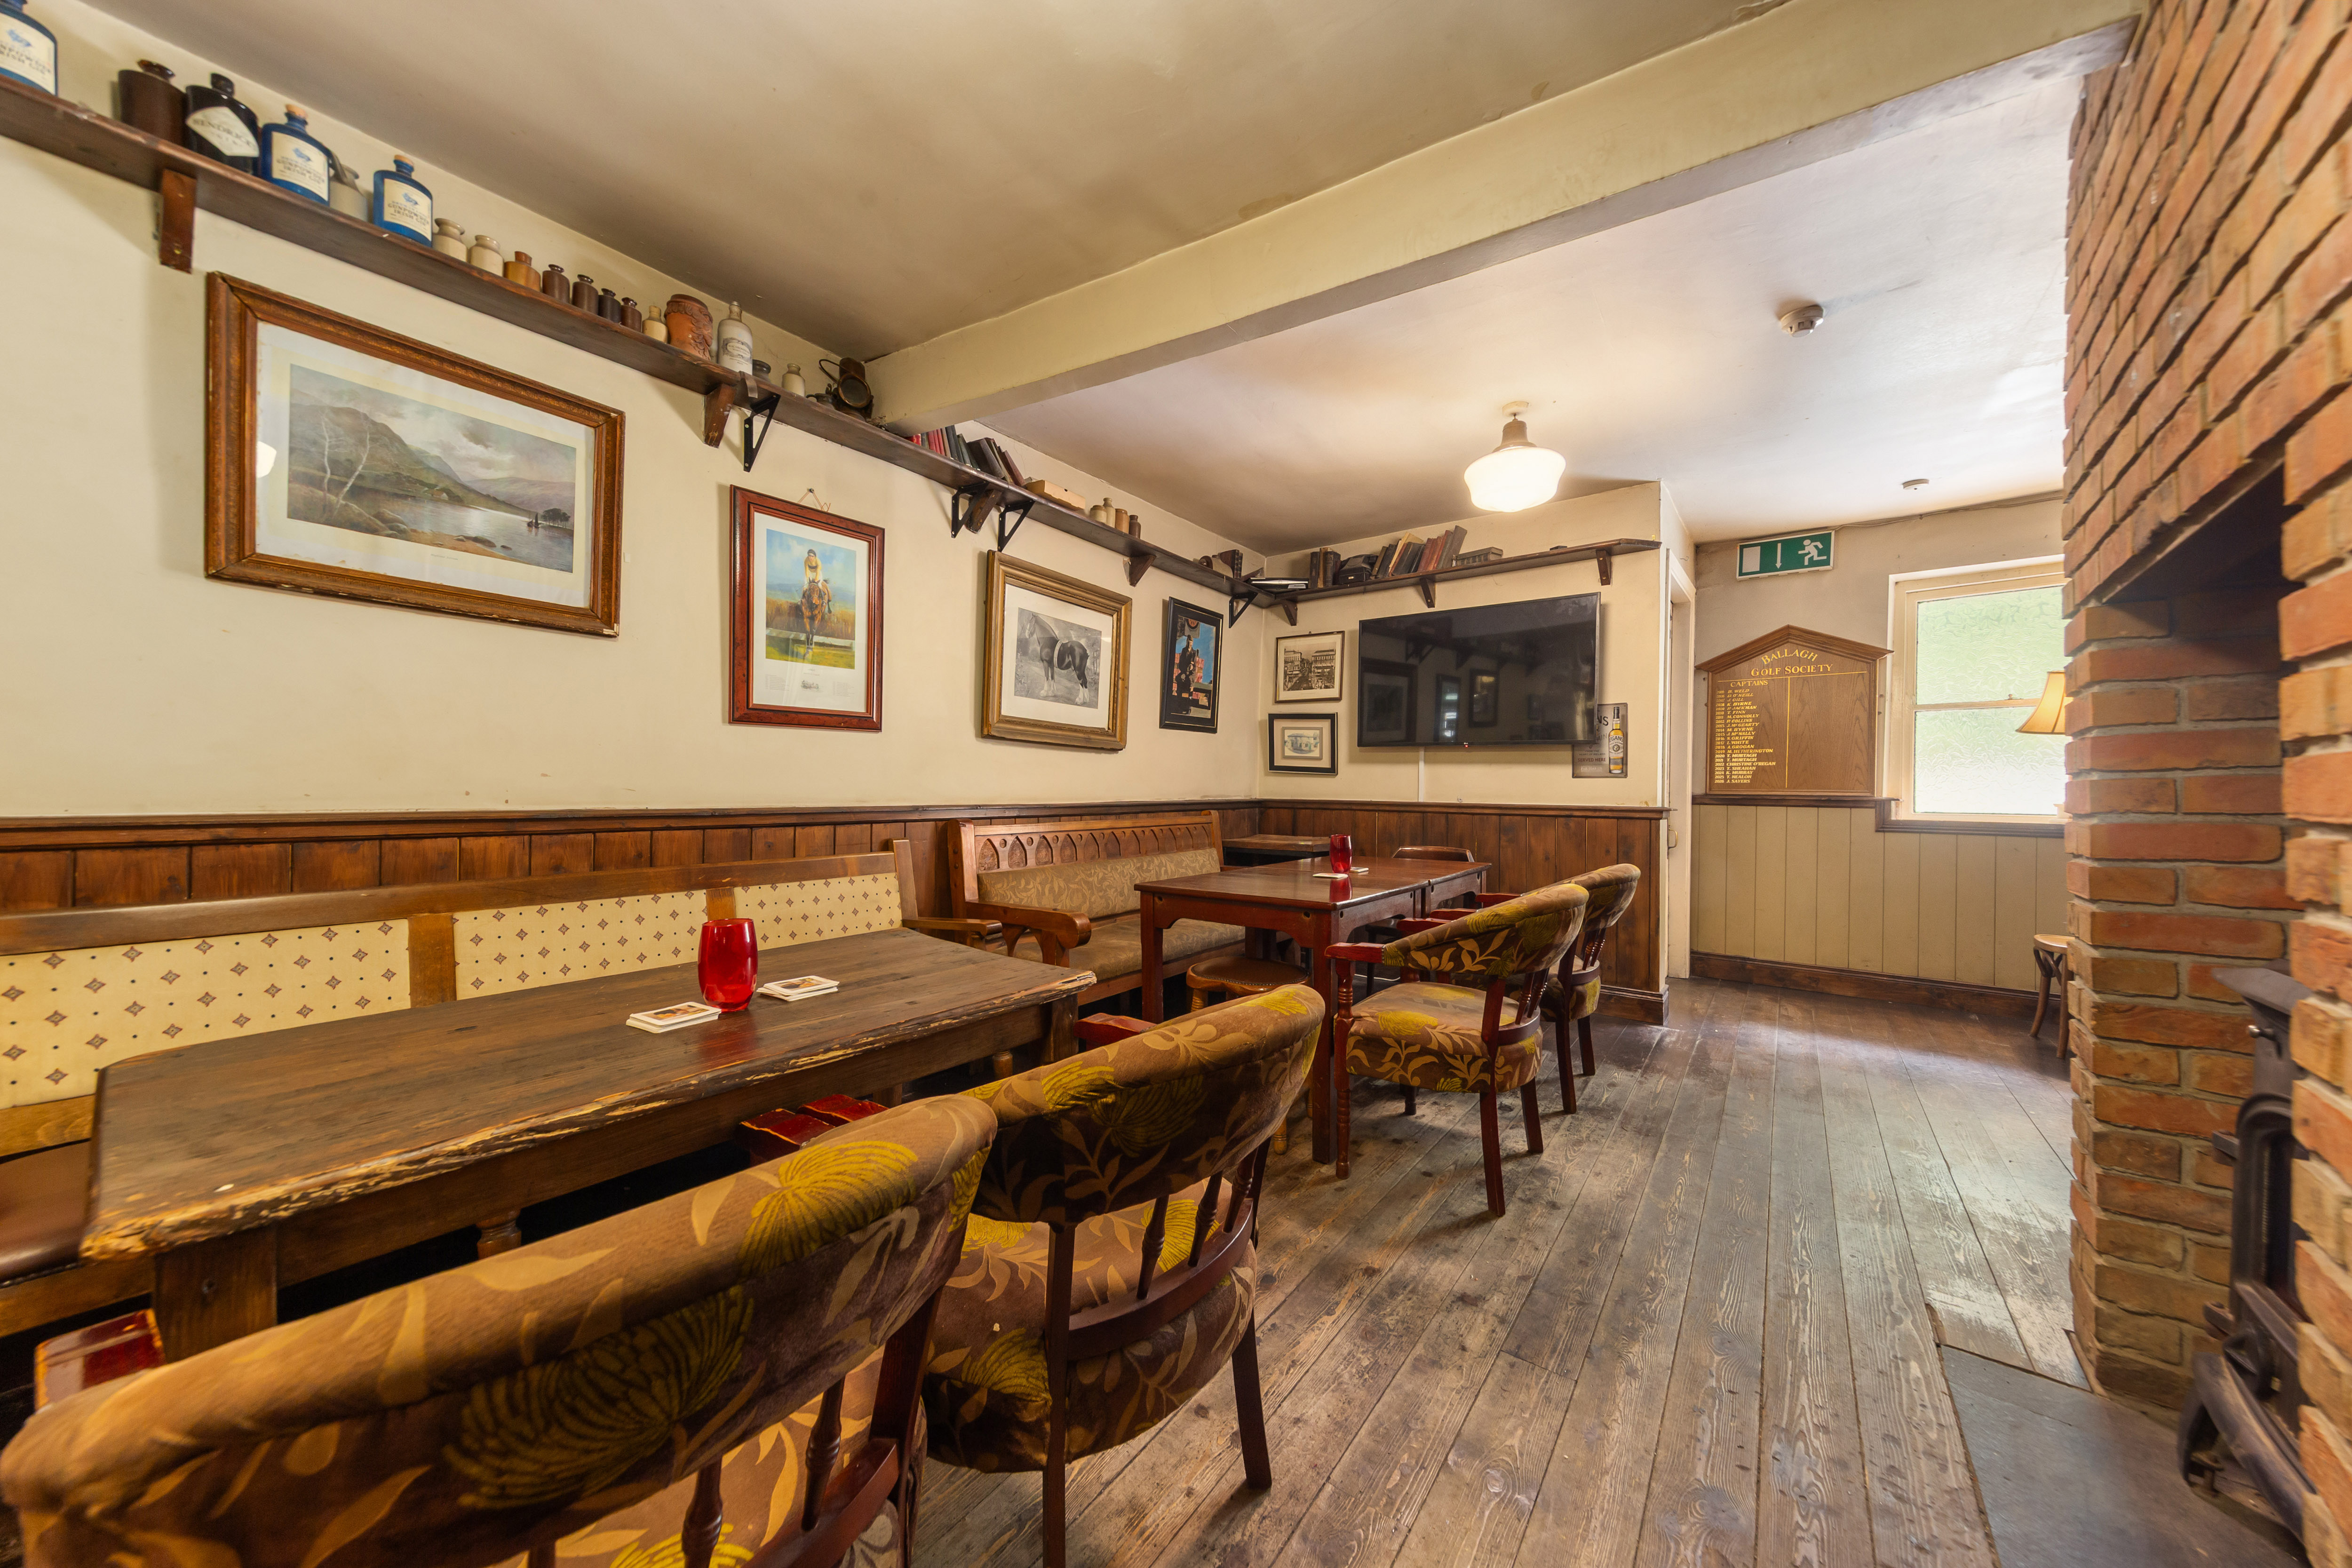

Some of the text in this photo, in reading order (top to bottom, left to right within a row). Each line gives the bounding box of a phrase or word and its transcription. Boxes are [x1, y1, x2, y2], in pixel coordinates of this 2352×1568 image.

[388, 203, 429, 224] GUNPOWDER
[394, 209, 414, 219] IRISH
[415, 216, 426, 226] GIN
[1761, 649, 1818, 665] BALLAGH
[1751, 664, 1833, 677] GOLF SOCIETY
